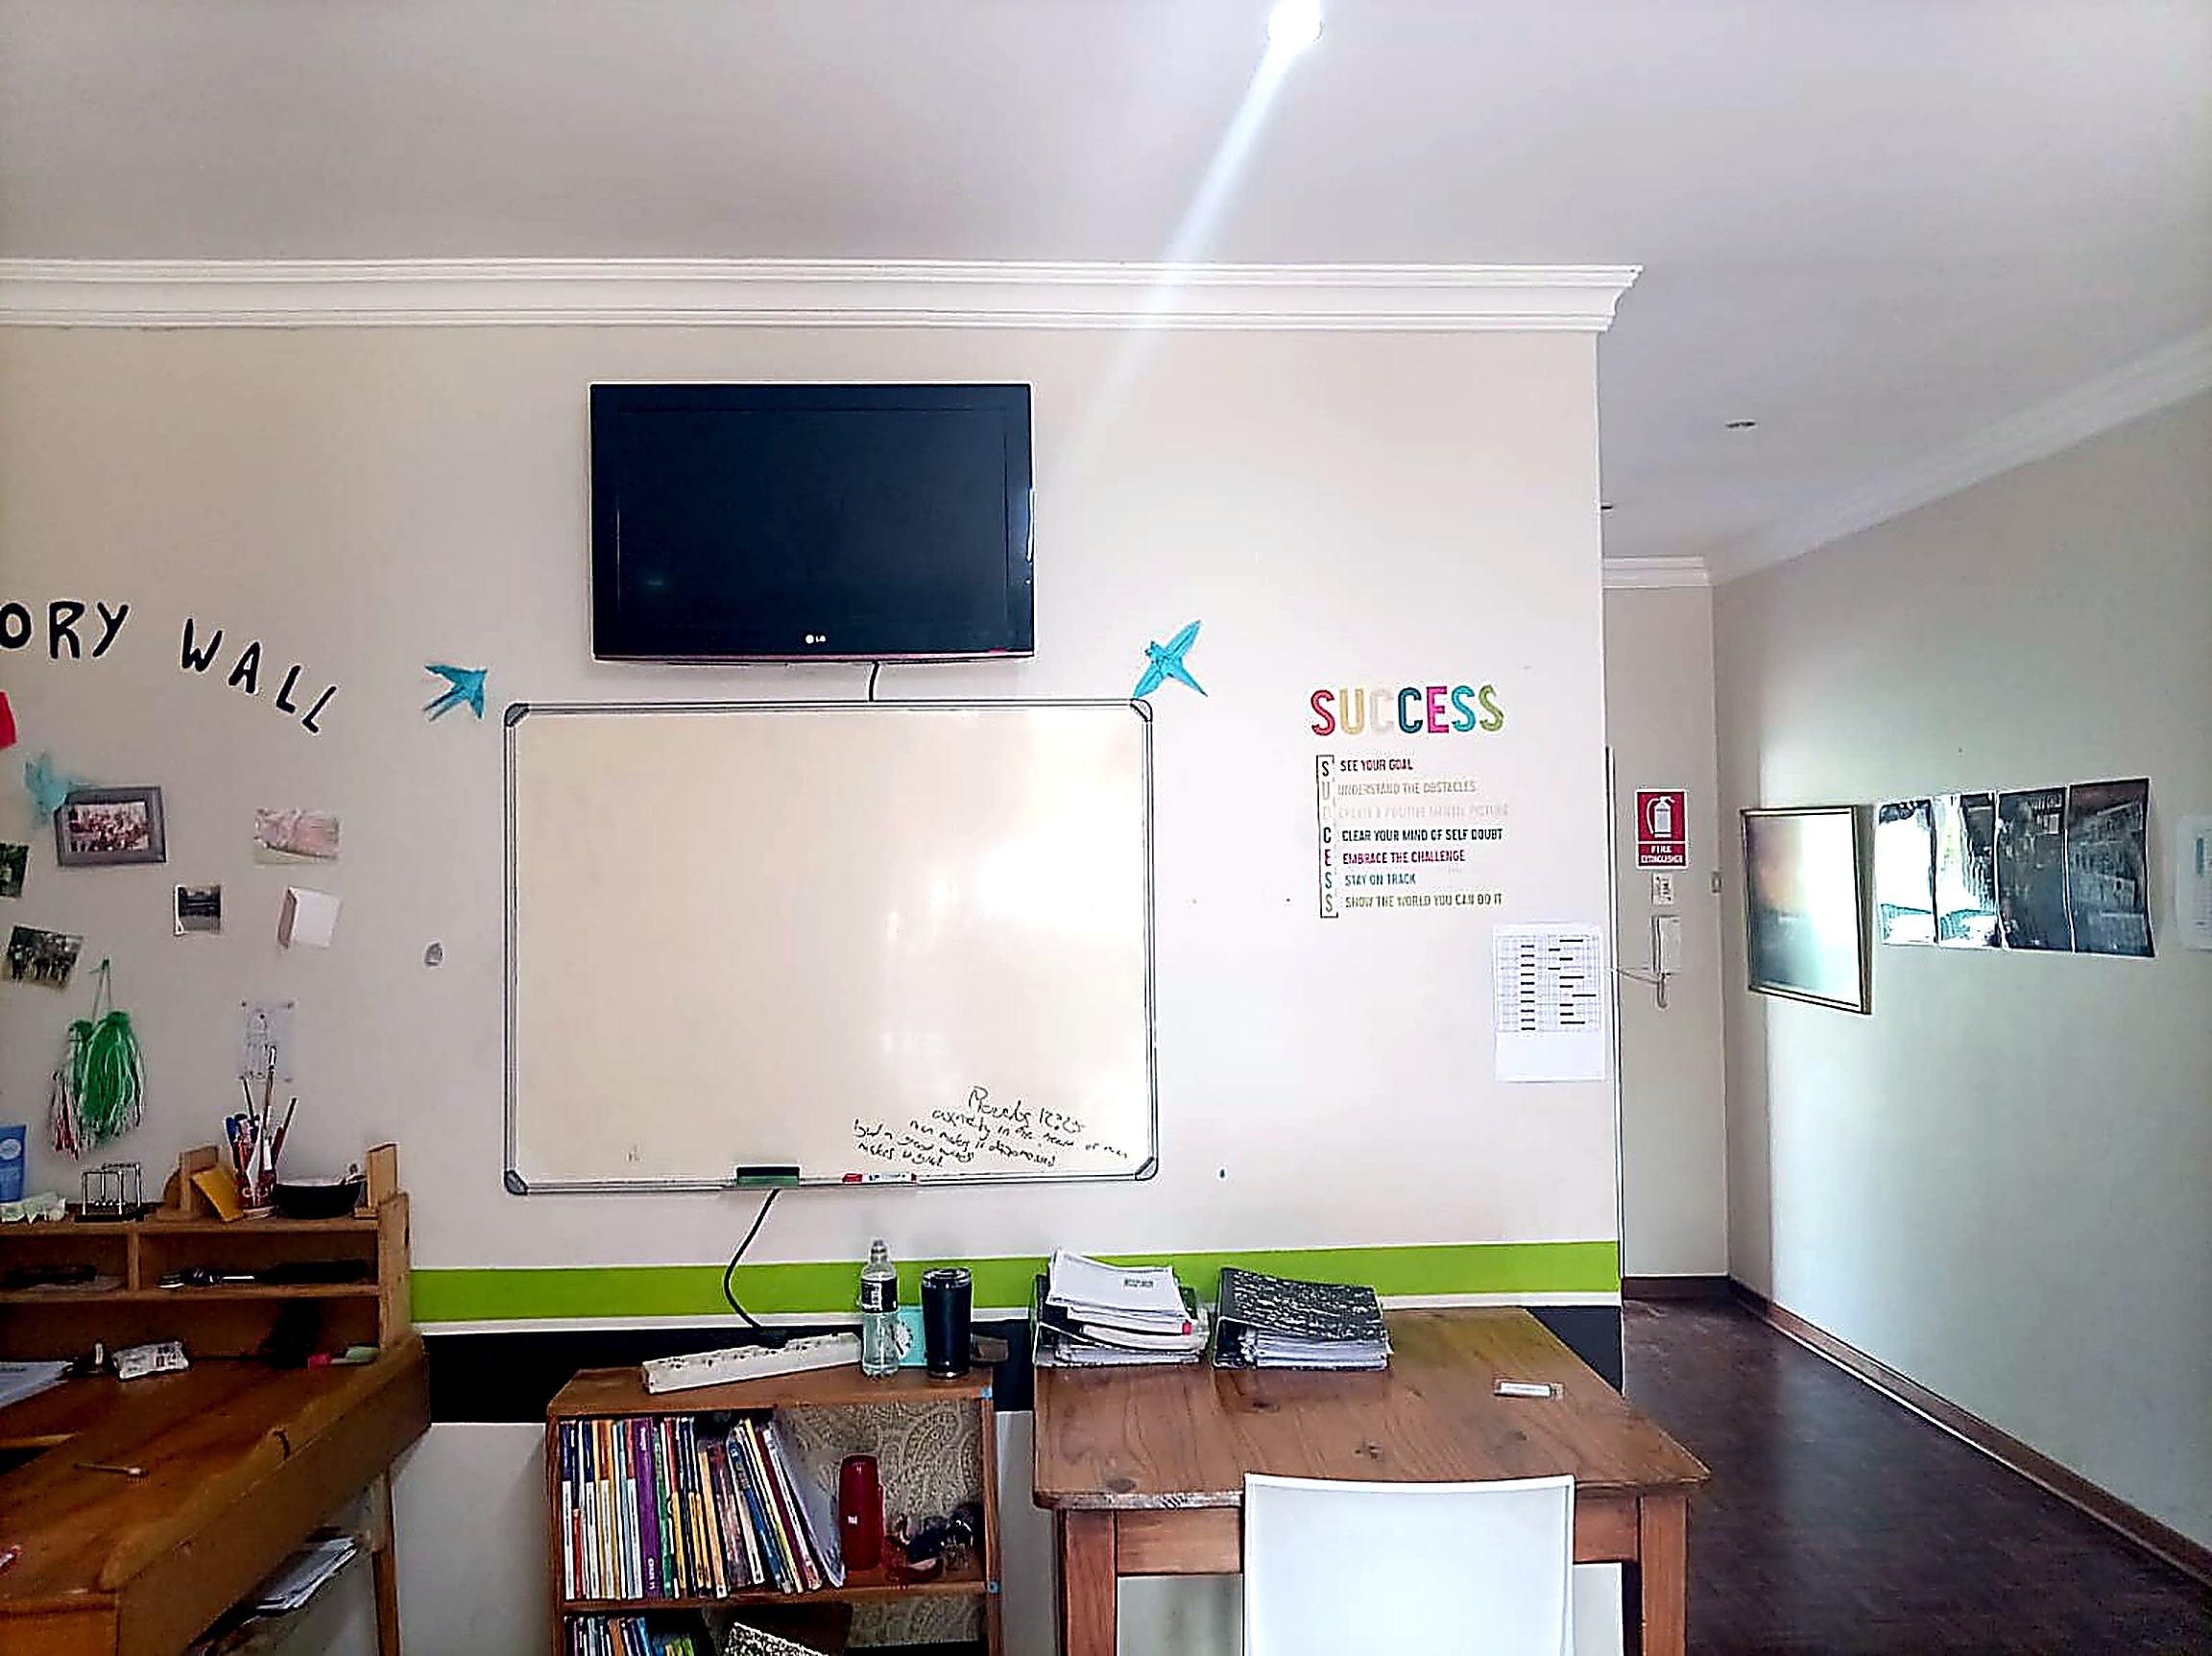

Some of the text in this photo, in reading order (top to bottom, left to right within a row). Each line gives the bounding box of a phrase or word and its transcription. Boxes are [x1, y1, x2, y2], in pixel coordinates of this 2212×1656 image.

[0, 601, 337, 733] ORY WALL
[1310, 684, 1504, 736] SUCCESS
[1340, 757, 1414, 772] SEE YOUR GOAL
[1338, 782, 1400, 796] UNDERSTAND
[1402, 782, 1420, 795] THE
[1341, 828, 1503, 842] CLEAR YOUR MIND OF SELF DOUBT
[1342, 849, 1467, 865] EMBRACE THE CHALLENGE
[1344, 873, 1417, 887] STAY ON TRACK
[1345, 893, 1503, 908] SHOW THE WORLD YOU CAN DO IT
